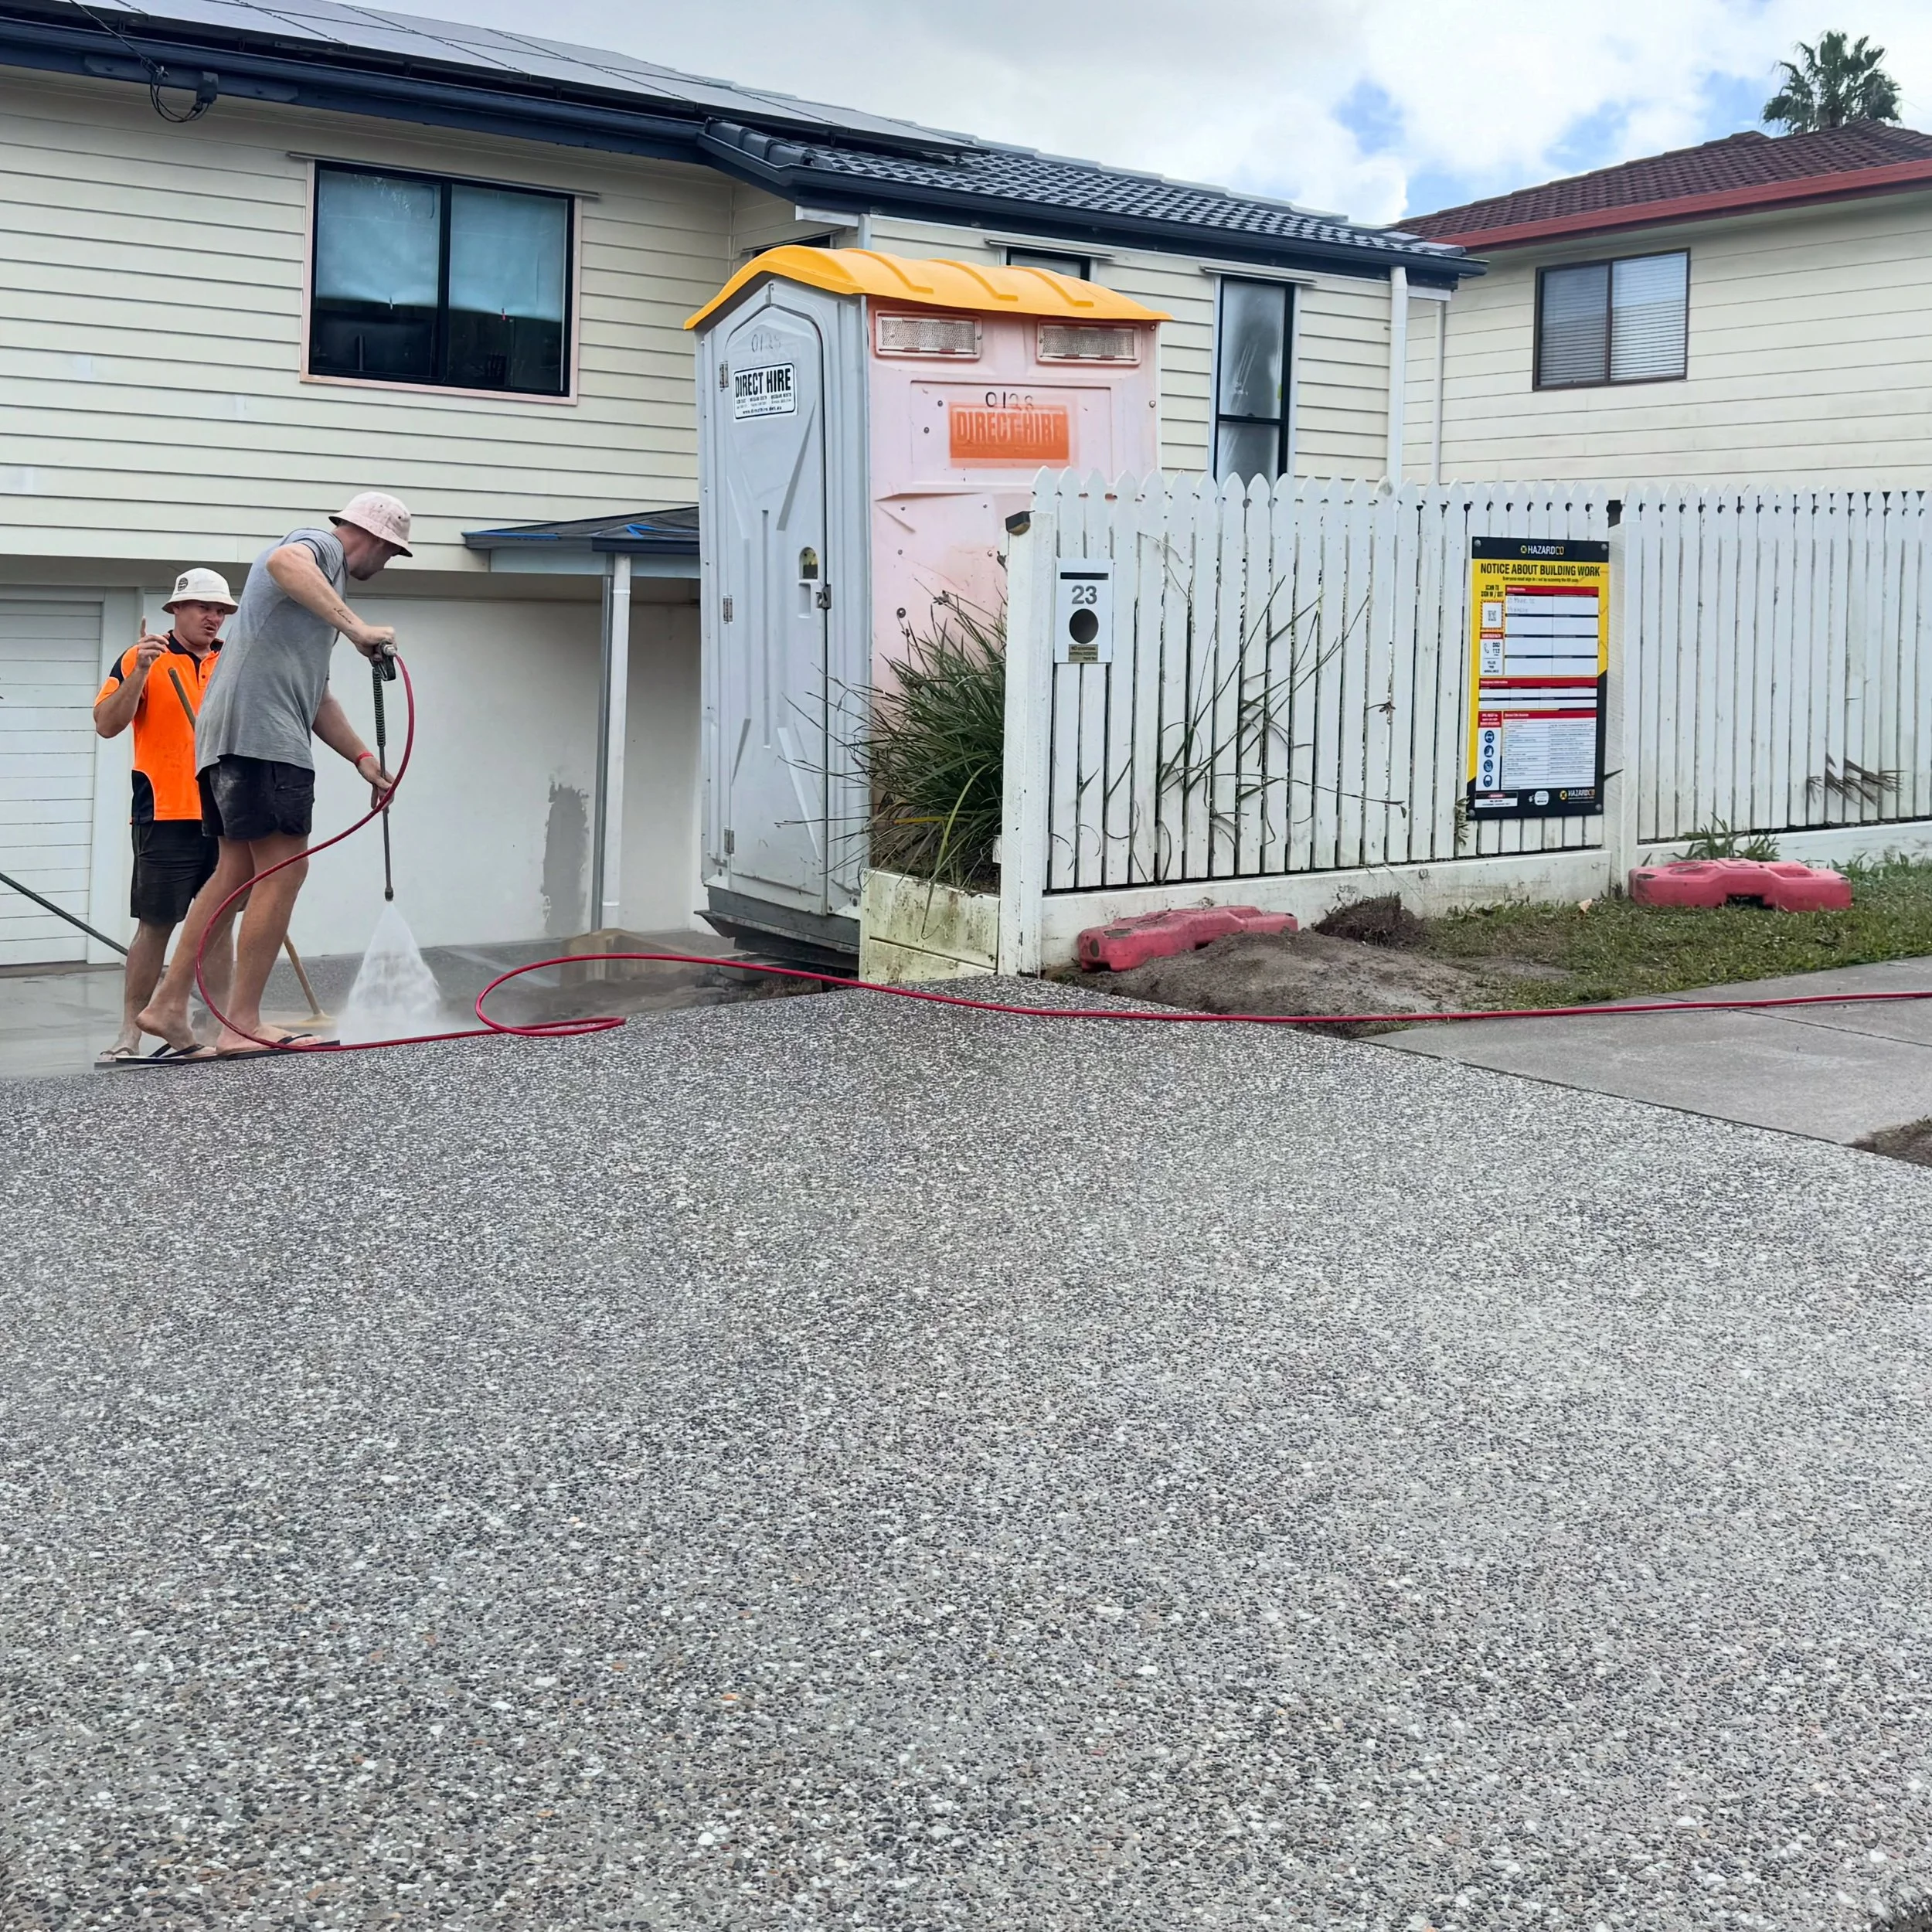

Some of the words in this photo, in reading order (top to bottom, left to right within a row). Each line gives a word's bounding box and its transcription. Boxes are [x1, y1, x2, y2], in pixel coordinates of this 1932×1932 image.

[735, 372, 763, 399] DIRECT
[767, 368, 791, 393] HIRE
[956, 410, 1021, 445] DIRECT
[1481, 563, 1510, 574] NOTICE
[1512, 564, 1538, 576] ABOUT
[1540, 565, 1576, 577] BUILDING
[1577, 566, 1600, 577] WORK
[1071, 584, 1097, 605] 23
